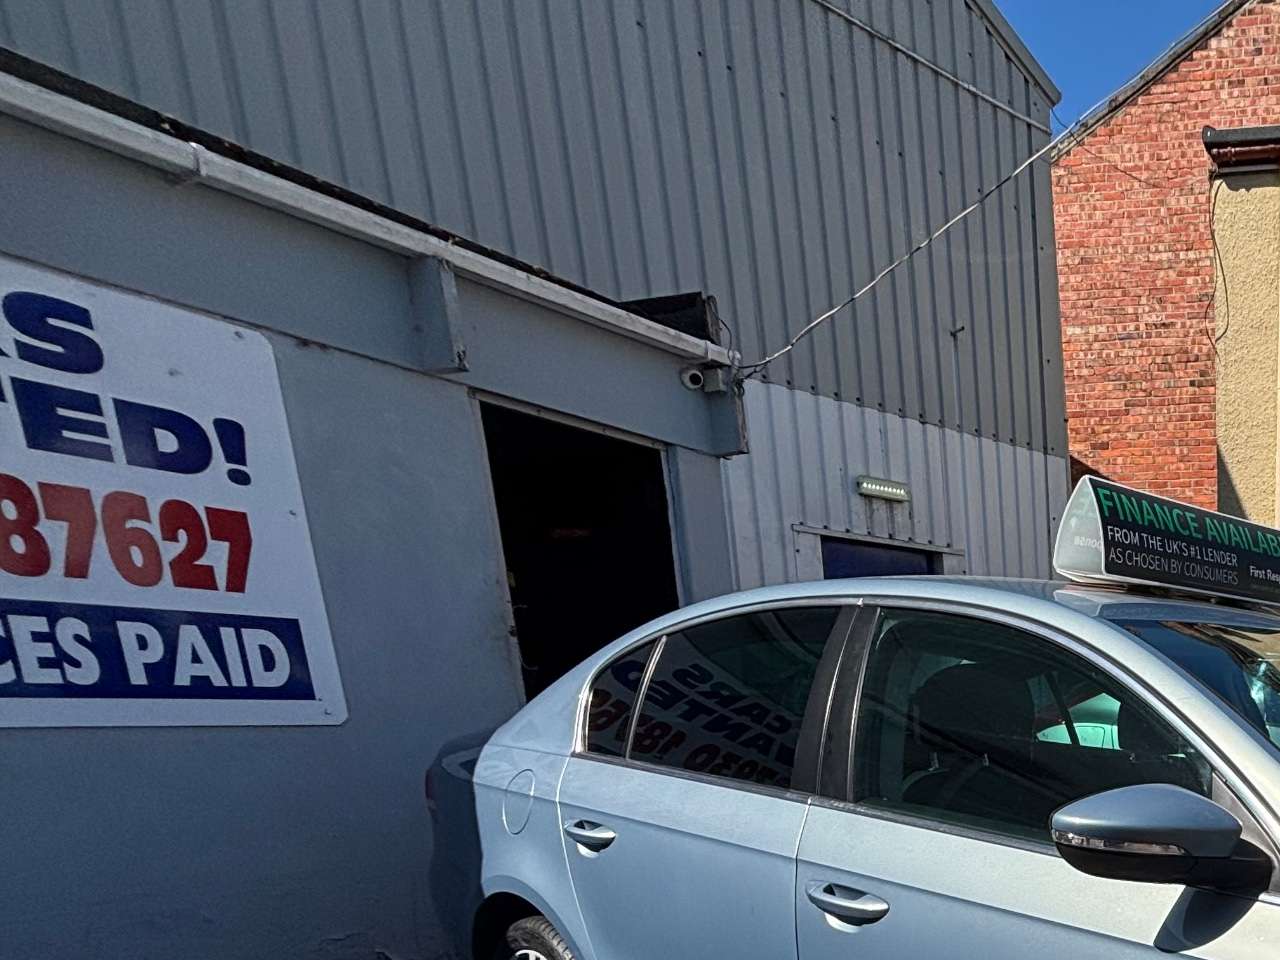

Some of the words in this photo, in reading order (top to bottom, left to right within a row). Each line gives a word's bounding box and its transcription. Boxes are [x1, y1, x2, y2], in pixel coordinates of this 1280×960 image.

[0, 374, 251, 486] ED!
[1097, 487, 1203, 539] FINANCE
[1107, 525, 1140, 547] FROM
[1141, 533, 1163, 551] THE
[1164, 538, 1188, 557] UK'S
[1190, 545, 1201, 560] #1
[1202, 547, 1238, 567] LENDER
[1109, 547, 1123, 563] AS
[1125, 550, 1169, 572] CHOSEN
[1170, 560, 1182, 574] BY
[1184, 562, 1239, 585] CONSUMERS
[1249, 565, 1266, 580] First
[116, 621, 291, 688] PAID
